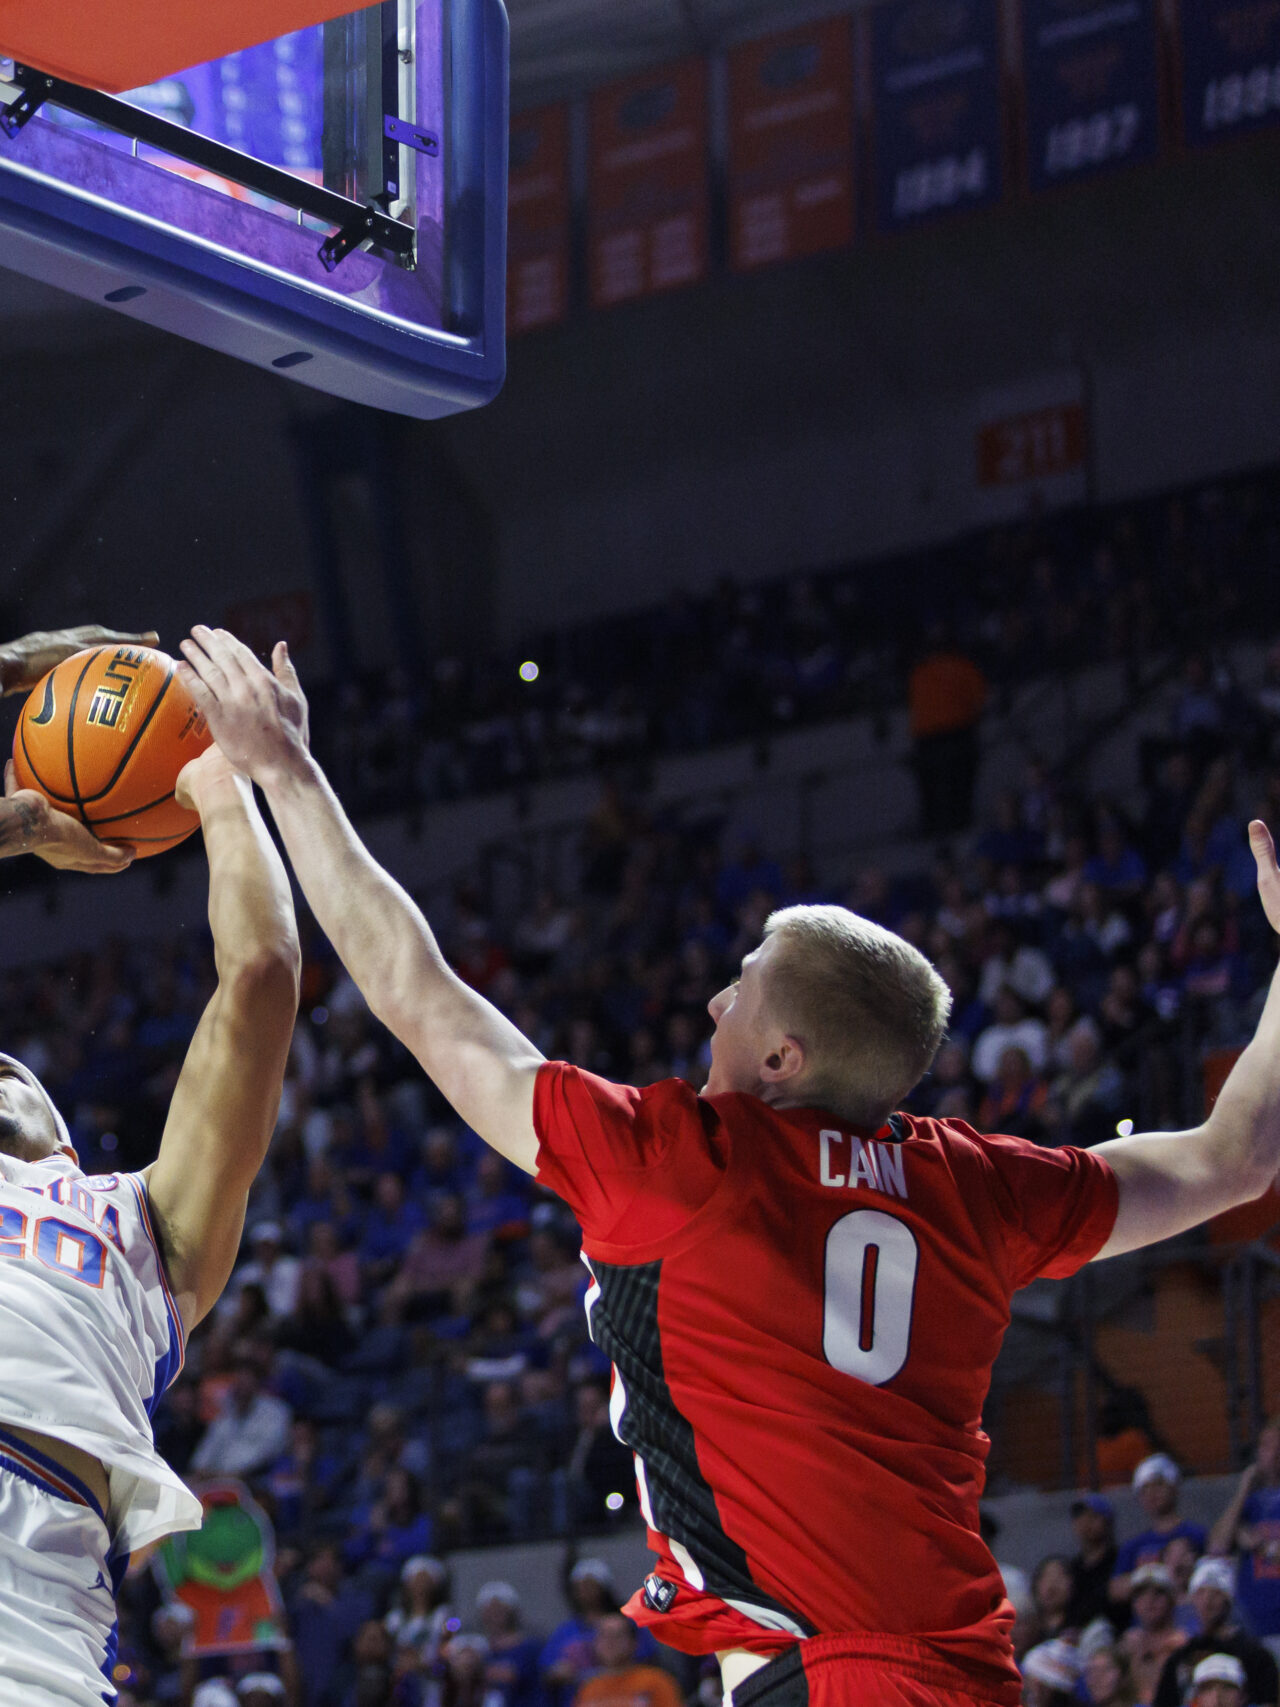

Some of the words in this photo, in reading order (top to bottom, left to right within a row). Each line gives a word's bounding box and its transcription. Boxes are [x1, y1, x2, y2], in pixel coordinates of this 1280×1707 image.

[86, 647, 146, 730] ELITE
[819, 1128, 909, 1200] CAIN
[822, 1208, 919, 1388] 0
